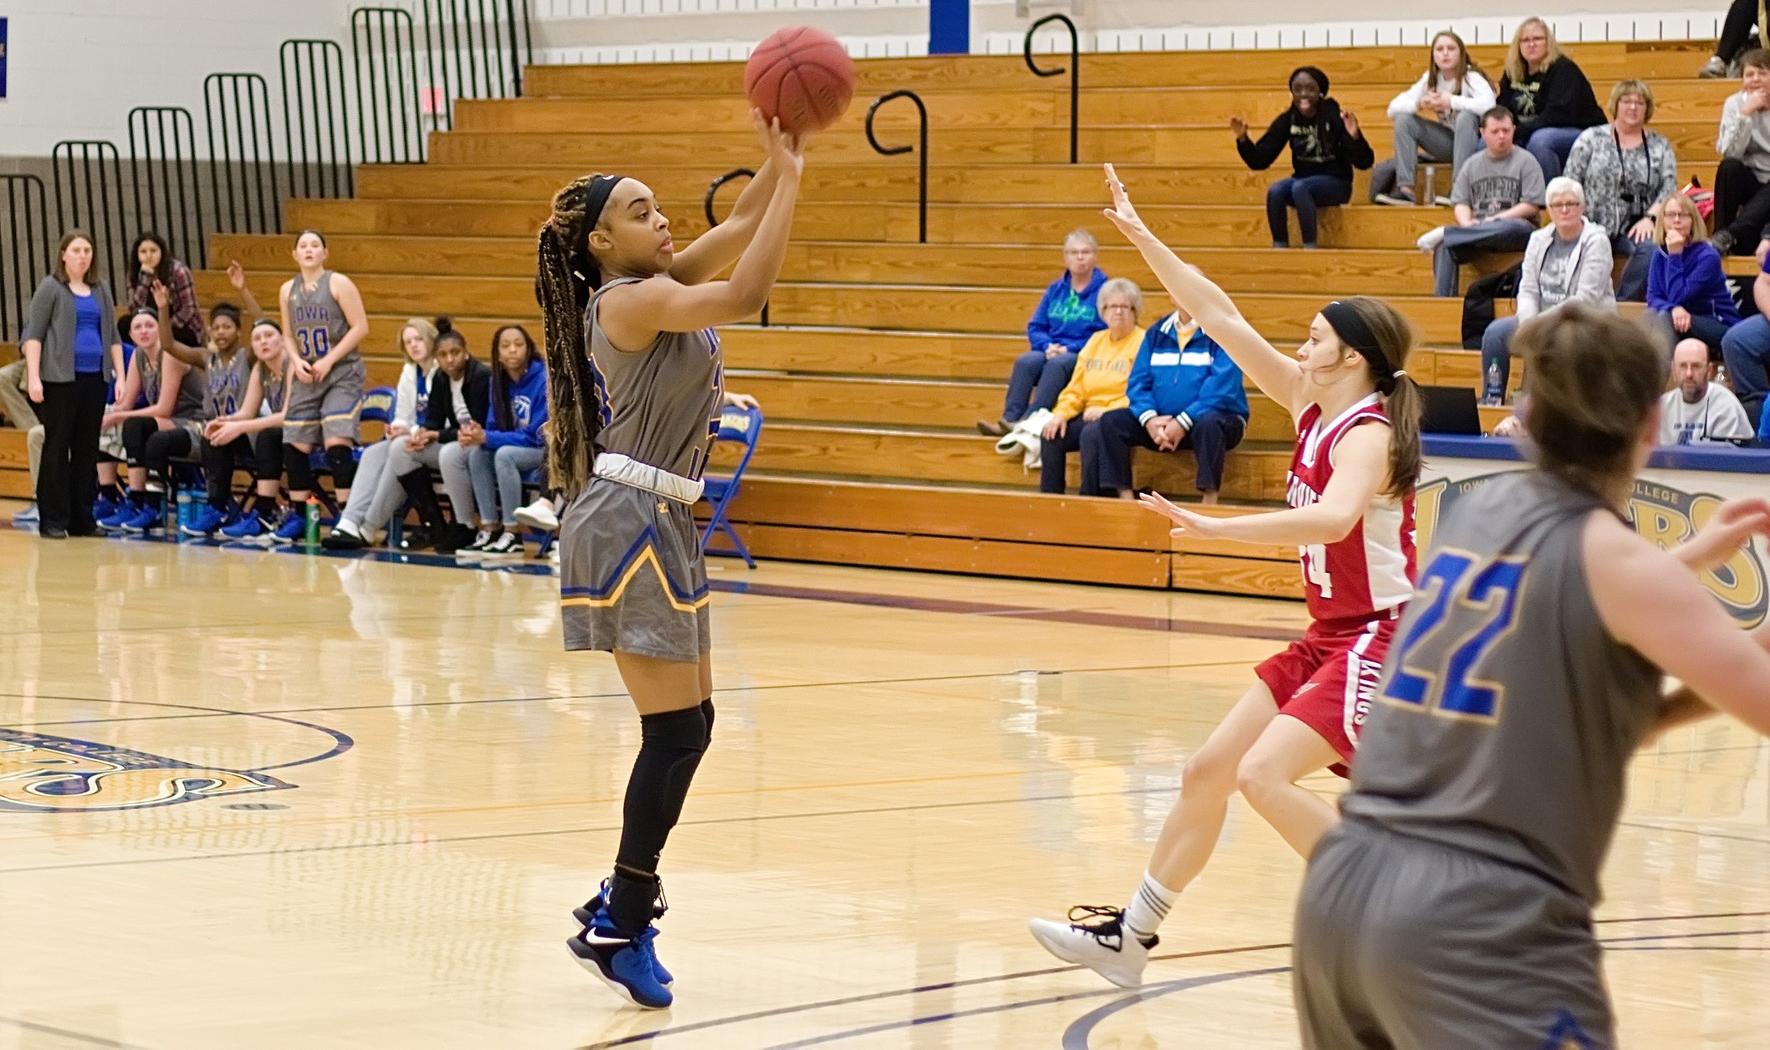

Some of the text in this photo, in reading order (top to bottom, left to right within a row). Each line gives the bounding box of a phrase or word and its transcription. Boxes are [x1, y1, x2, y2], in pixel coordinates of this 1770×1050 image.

[295, 326, 331, 358] 30
[1378, 546, 1530, 726] 22
[1354, 659, 1382, 726] KINGS
